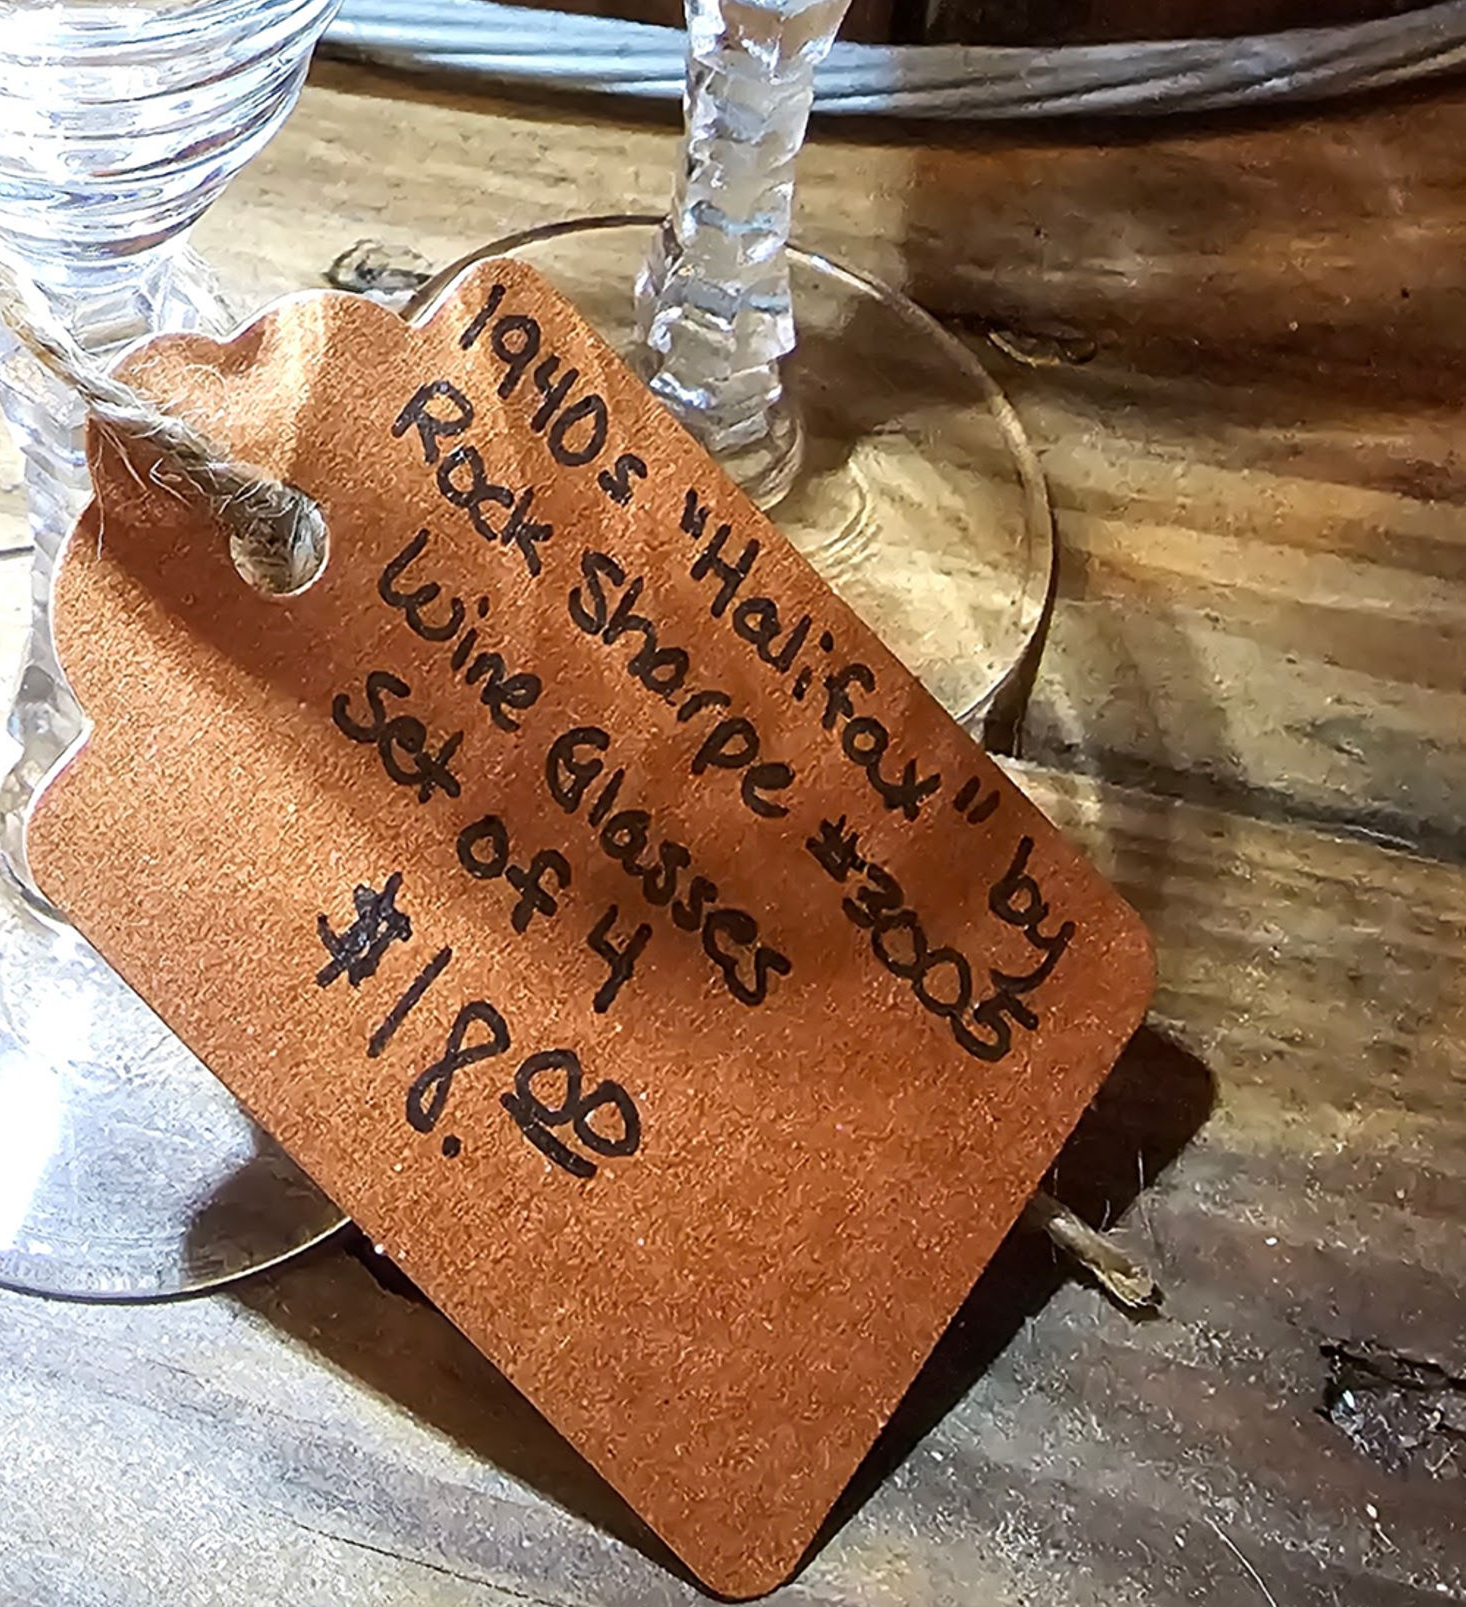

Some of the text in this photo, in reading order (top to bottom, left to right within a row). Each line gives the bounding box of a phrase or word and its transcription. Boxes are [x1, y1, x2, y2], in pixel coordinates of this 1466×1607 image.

[334, 670, 654, 1013] Set of 4
[379, 530, 792, 1006] Wine Glasses
[392, 381, 1039, 1062] Rock Sharpe #3005
[461, 283, 1075, 994] 1940s "Halifax" by
[316, 872, 640, 1180] $18.00
